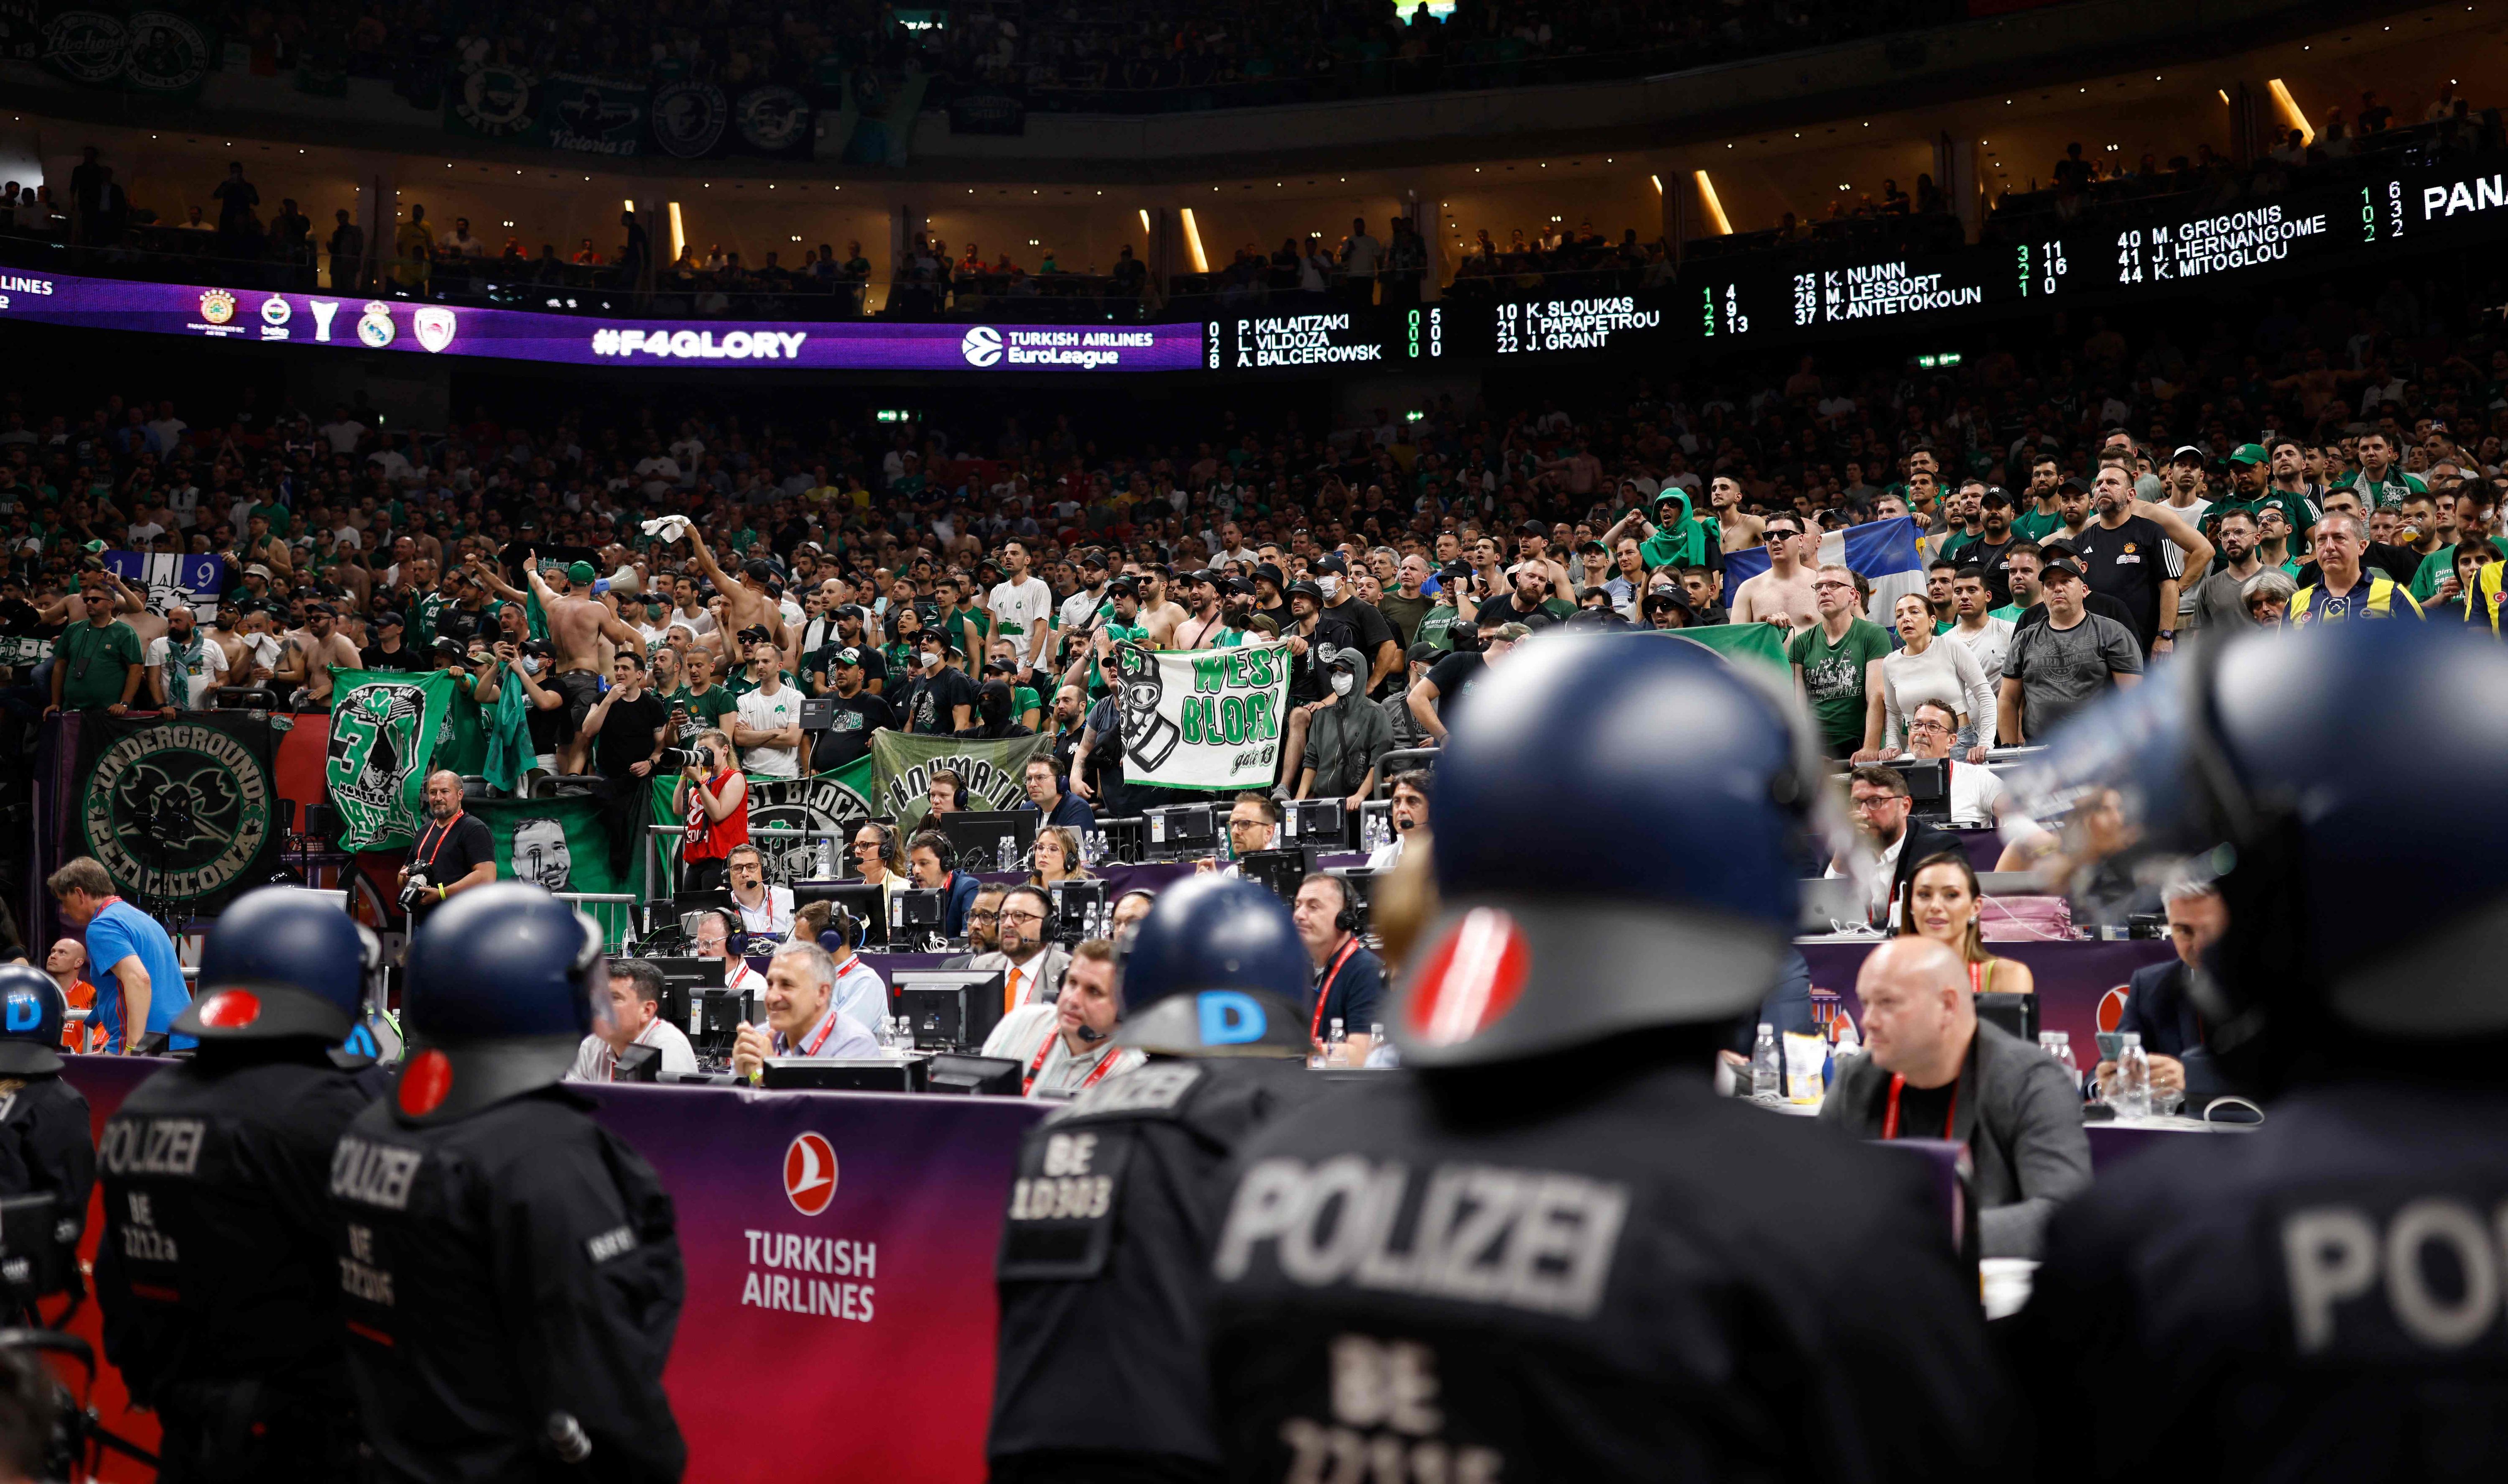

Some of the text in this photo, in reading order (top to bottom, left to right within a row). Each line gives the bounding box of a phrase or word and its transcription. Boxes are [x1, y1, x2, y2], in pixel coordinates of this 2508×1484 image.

[2118, 181, 2401, 249] 40 M. GRIGONIS 1 6
[2424, 173, 2508, 221] PAN
[2118, 200, 2403, 267] 41 J. HERNANGOME 0 3
[2119, 219, 2404, 284] 44 K. MITOGLOU 2 2
[1794, 240, 2061, 291] 25 K. NUNN 3 11
[1794, 257, 2067, 308] 26 M. LESSORT 2 16
[1209, 308, 1440, 336] 0 P. KALAITZAKI 0 5
[1497, 284, 1736, 321] 10 K. SLOUKAS 1 4
[1497, 301, 1737, 336] 21 I. PAPAPETROU 2 9
[1795, 307, 1816, 326] 37
[2019, 280, 2027, 296] 1
[2044, 277, 2056, 294] 0
[592, 329, 806, 359] #F4GLORY
[1008, 347, 1119, 369] EuroLeague
[1009, 332, 1153, 347] TURKISH AIRLINES
[1209, 325, 1441, 353] 2 L. VILDOZA 0 0
[1209, 341, 1441, 369] 8 A. BALCEROWSK 0 0
[1497, 316, 1748, 353] 22 J. GRANT 2 13
[196, 562, 214, 588] 9
[1192, 646, 1287, 694] WEST
[1181, 688, 1279, 746] BLOCK
[92, 725, 265, 800] UNDERGROUND
[1230, 744, 1276, 777] gate 13
[784, 782, 869, 822] BLOCK
[6, 993, 42, 1031] D
[1197, 989, 1268, 1046] D
[1043, 1133, 1098, 1177] BE
[744, 1229, 877, 1279] TURKISH
[1213, 1153, 1632, 1324] POLIZEI
[742, 1271, 875, 1323] AIRLINES
[2282, 1196, 2508, 1356] PO
